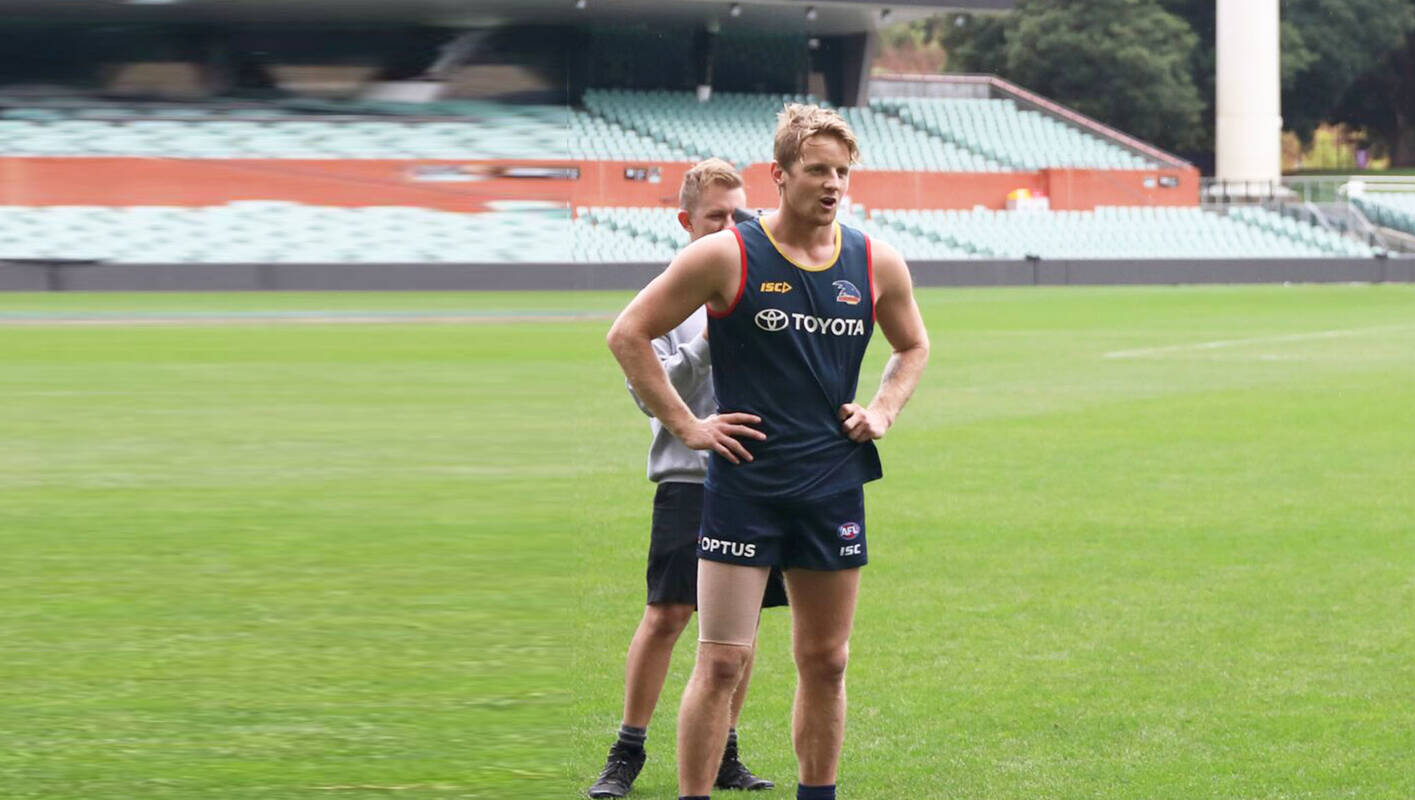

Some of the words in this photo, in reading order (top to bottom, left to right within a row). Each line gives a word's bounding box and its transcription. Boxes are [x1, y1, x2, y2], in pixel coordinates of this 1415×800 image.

[760, 281, 784, 294] ISC
[791, 312, 865, 336] TOYOTA
[840, 525, 860, 536] AFL
[701, 536, 757, 558] OPTUS
[840, 543, 861, 557] ISC
